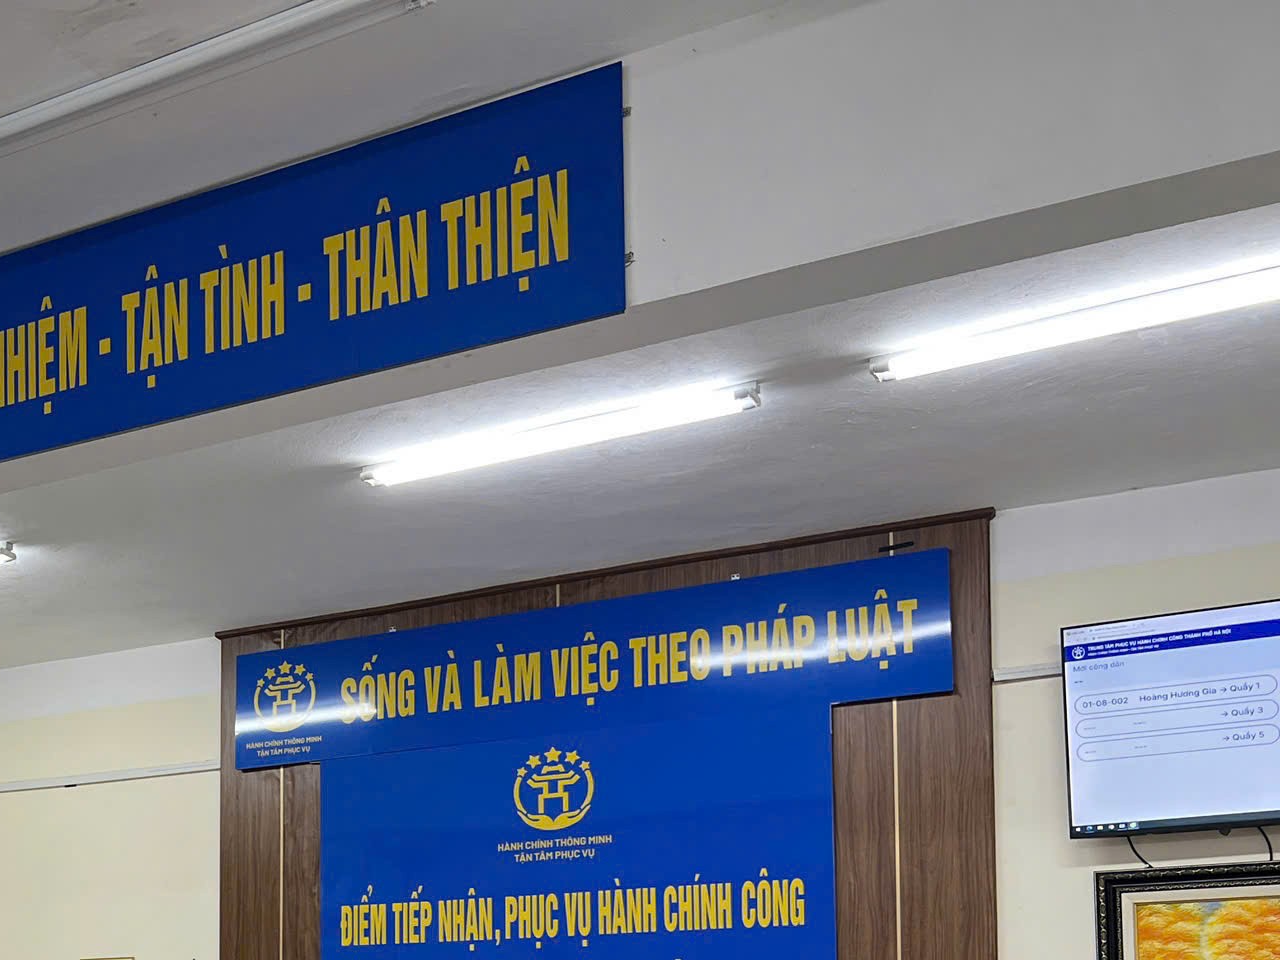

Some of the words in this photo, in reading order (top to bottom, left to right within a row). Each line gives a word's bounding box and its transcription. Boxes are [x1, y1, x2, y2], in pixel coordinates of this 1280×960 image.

[121, 264, 189, 388] TẬN
[200, 245, 285, 354] TÌNH
[323, 196, 428, 321] THÂN
[441, 156, 569, 292] THIỆN
[340, 654, 415, 724] SỐNG
[424, 650, 462, 714] VÀ
[473, 643, 541, 708] LÀM
[550, 631, 619, 706] VIỆC
[628, 628, 711, 688] THEO
[722, 603, 816, 677] PHÁP
[827, 589, 918, 669] LUẬT
[497, 841, 524, 852] HÀNH
[524, 838, 553, 850] CHÍNH
[554, 836, 587, 847] THÔNG
[588, 834, 613, 845] MINH
[514, 852, 533, 864] TẬN
[534, 850, 553, 861] TÂM
[555, 849, 581, 861] PHỤC
[581, 848, 595, 859] VỤ
[340, 885, 387, 946] ĐIỂM
[392, 885, 432, 944] TIẾP
[438, 888, 501, 951] NHẬN,
[505, 893, 559, 949] PHỤC
[564, 891, 592, 947] VỤ
[598, 877, 657, 936] HÀNH
[663, 873, 732, 932] CHÍNH
[740, 868, 806, 929] CÔNG
